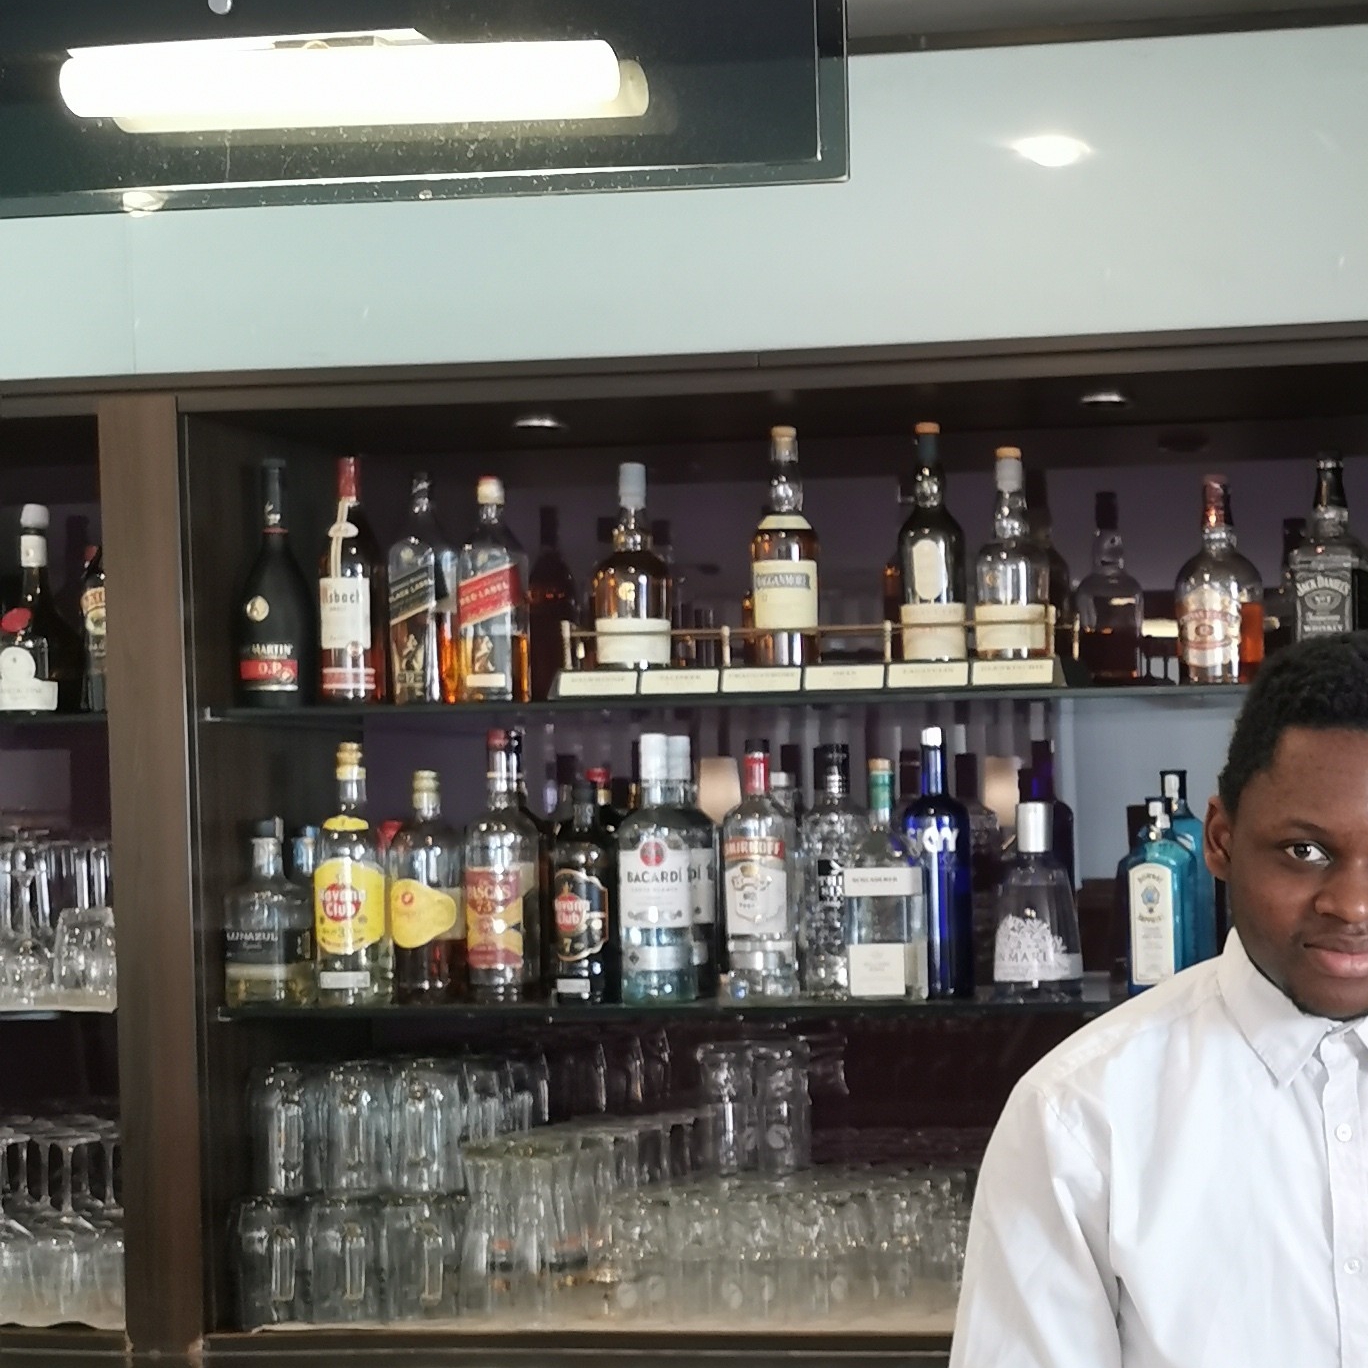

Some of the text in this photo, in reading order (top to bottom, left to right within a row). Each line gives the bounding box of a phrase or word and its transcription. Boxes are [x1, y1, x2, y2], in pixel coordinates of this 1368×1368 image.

[478, 579, 509, 598] LABEL
[626, 867, 682, 883] BACARDÍ
[325, 903, 357, 919] Club
